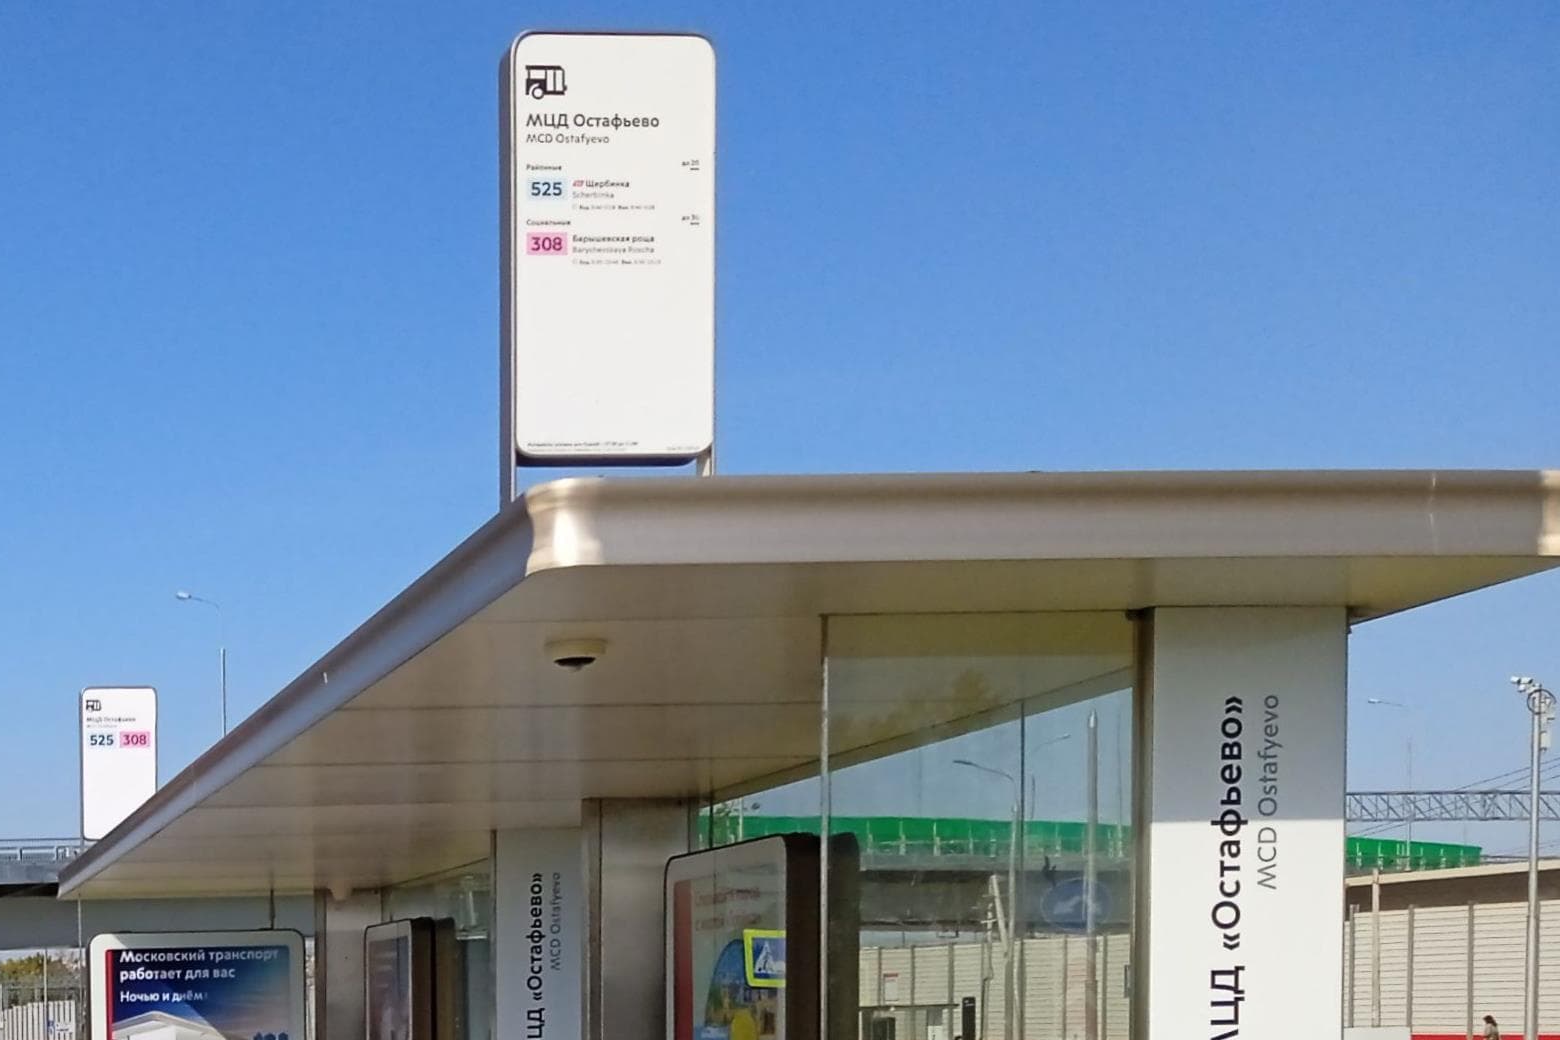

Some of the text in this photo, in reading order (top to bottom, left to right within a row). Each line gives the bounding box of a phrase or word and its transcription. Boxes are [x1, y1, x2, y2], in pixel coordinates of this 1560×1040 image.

[526, 113, 660, 131] МЦД Остафьево
[526, 133, 610, 145] MCD Ostafyevo
[531, 181, 562, 196] 525
[531, 236, 563, 252] 308
[90, 734, 147, 746] 525 308
[1257, 694, 1283, 890] MCD Ostafyevo
[1210, 696, 1248, 951] «Остафьево»
[549, 872, 563, 971] MCD Ostafyevo
[525, 872, 547, 1001] «Остафьево»
[119, 949, 280, 963] Московский транспорт
[119, 967, 236, 983] работает для вас
[120, 991, 160, 1003] Ночью
[162, 992, 170, 1002] и
